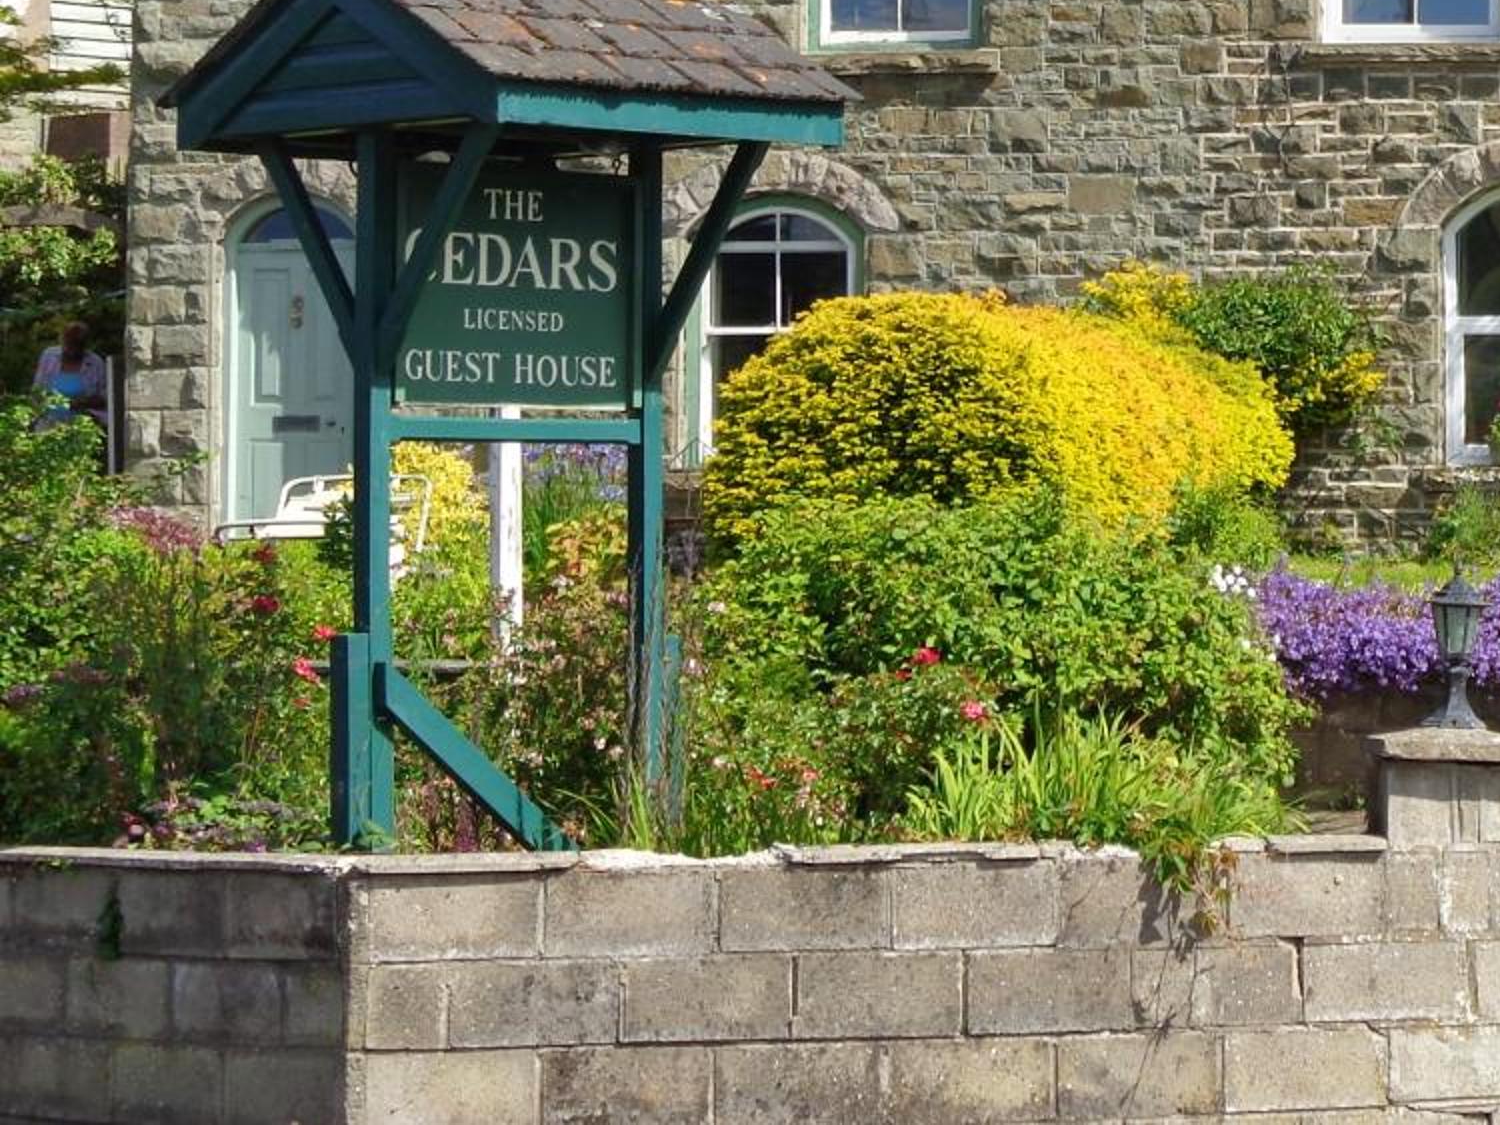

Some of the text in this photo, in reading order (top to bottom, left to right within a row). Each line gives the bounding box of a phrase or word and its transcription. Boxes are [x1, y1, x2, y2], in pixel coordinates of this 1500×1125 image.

[484, 188, 544, 222] THE
[463, 308, 564, 332] LICENSED
[404, 348, 617, 387] GUEST HOUSE
